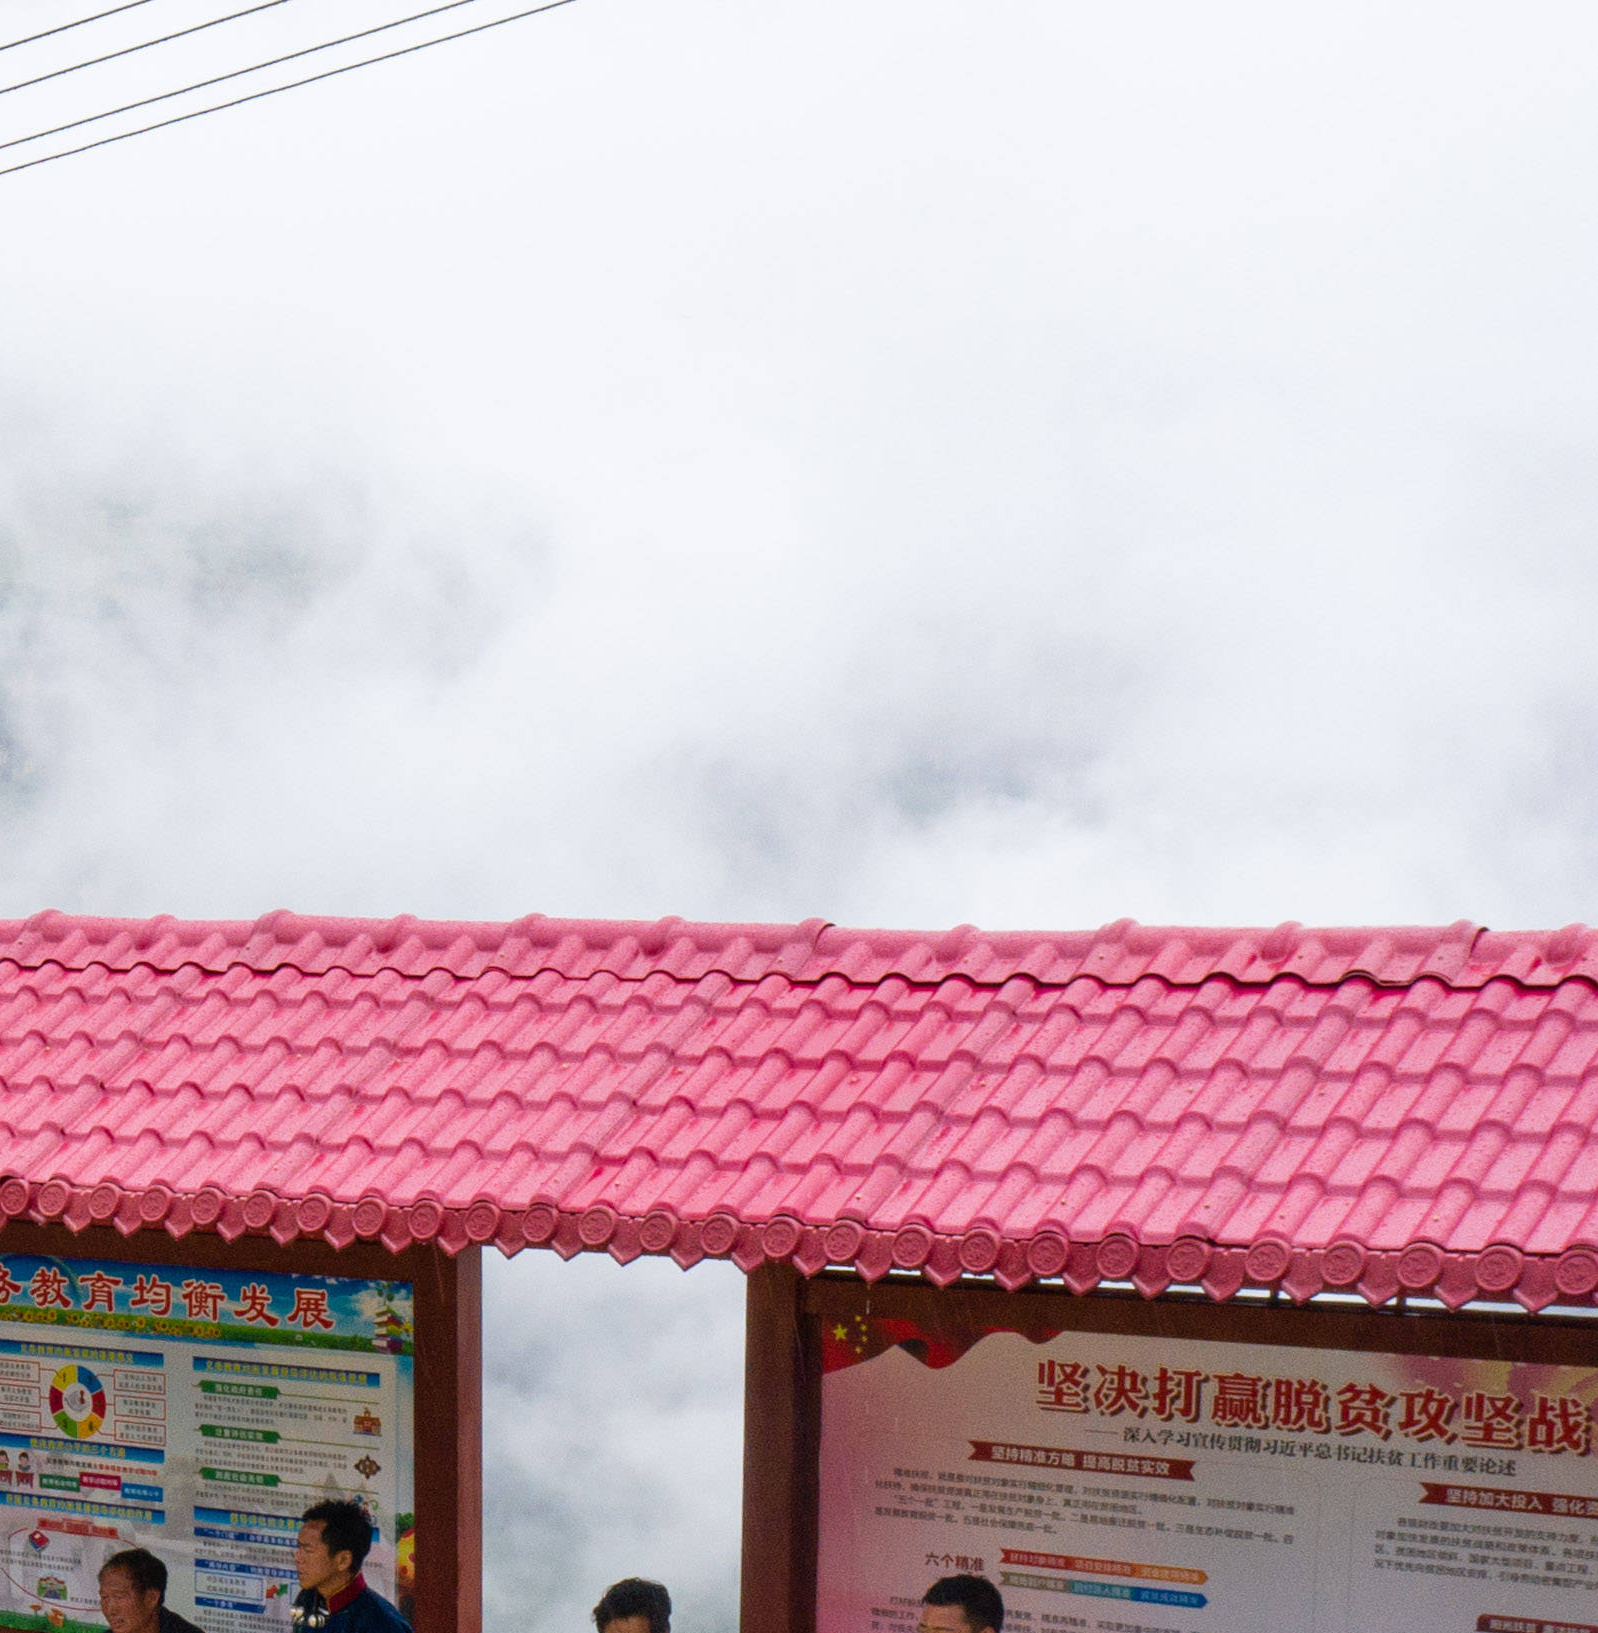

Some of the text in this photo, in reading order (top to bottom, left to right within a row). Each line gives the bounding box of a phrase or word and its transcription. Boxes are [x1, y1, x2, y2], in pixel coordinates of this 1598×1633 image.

[1036, 1359, 1591, 1457] 坚决打赢脱贫攻坚战
[925, 1552, 985, 1572] 六个精准
